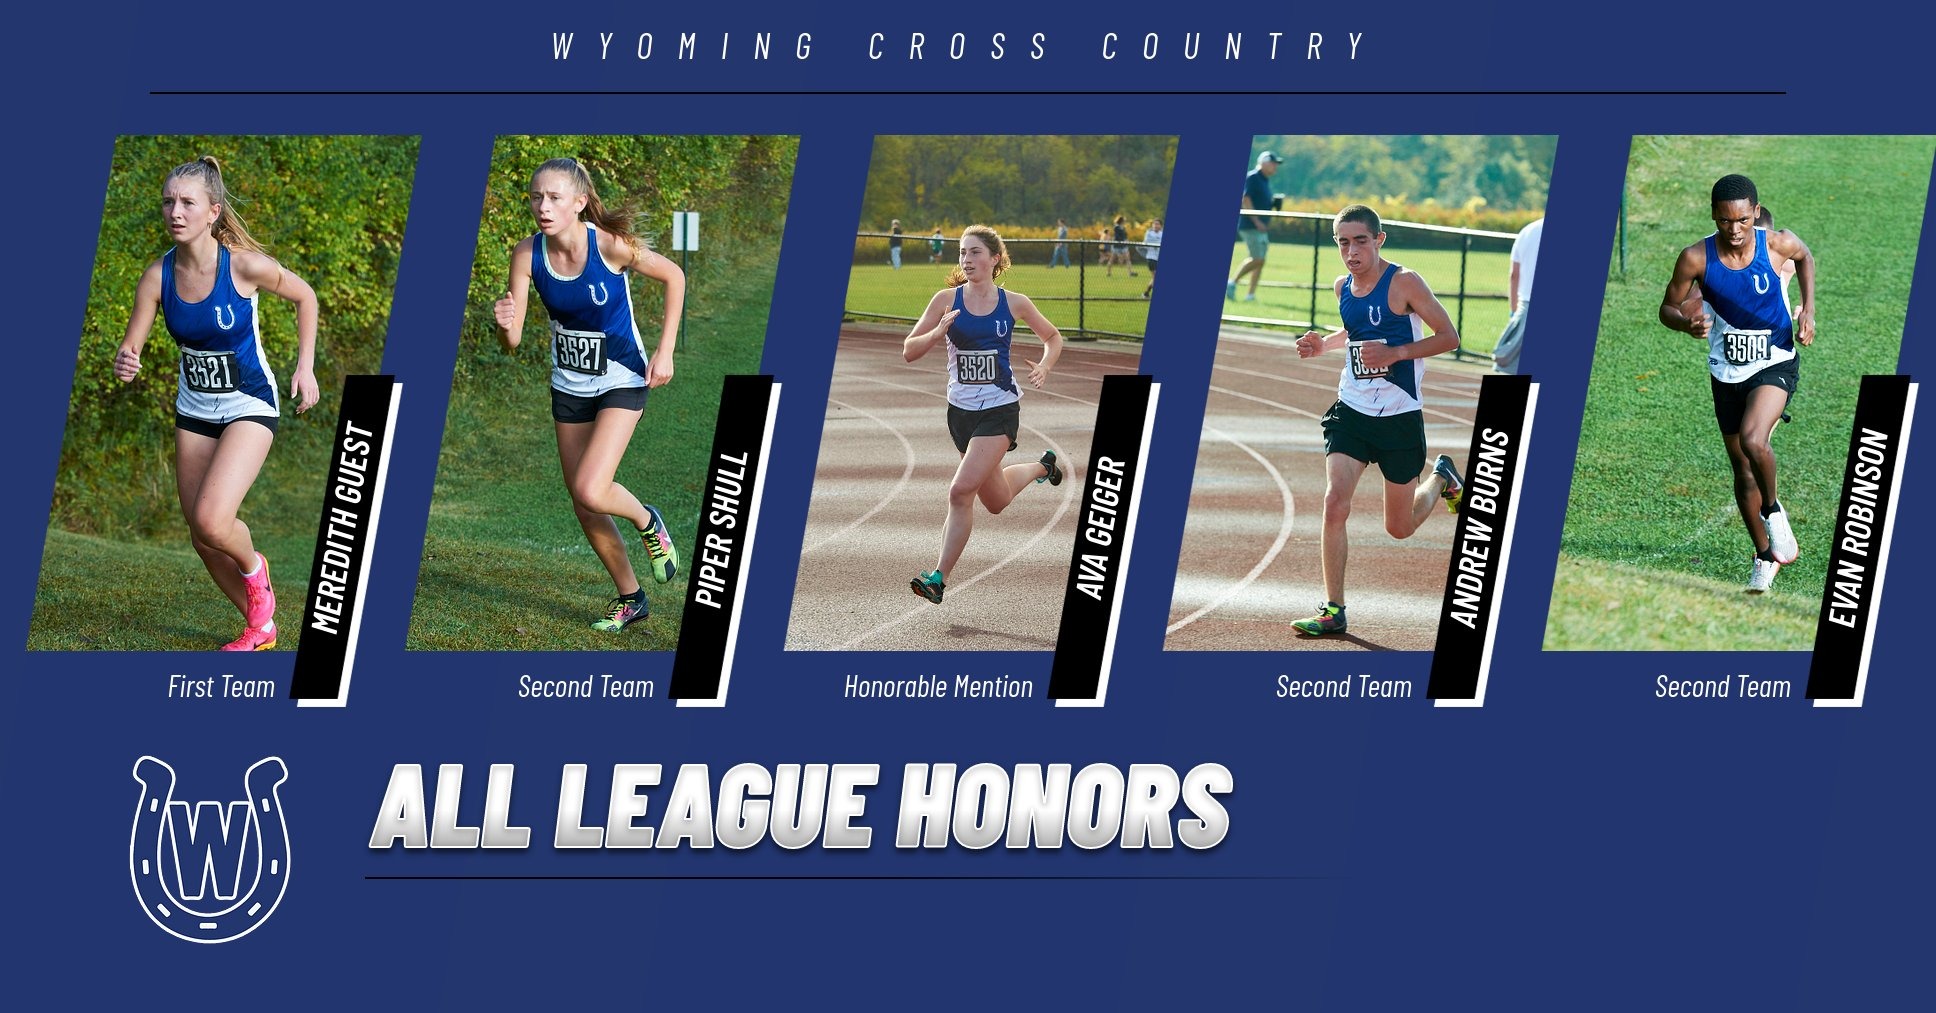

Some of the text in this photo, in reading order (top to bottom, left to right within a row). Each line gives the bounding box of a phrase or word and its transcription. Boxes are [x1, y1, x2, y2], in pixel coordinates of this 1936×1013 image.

[557, 334, 601, 371] 3527
[1727, 334, 1767, 362] 3509
[186, 354, 233, 389] 3521
[960, 355, 996, 381] 3520
